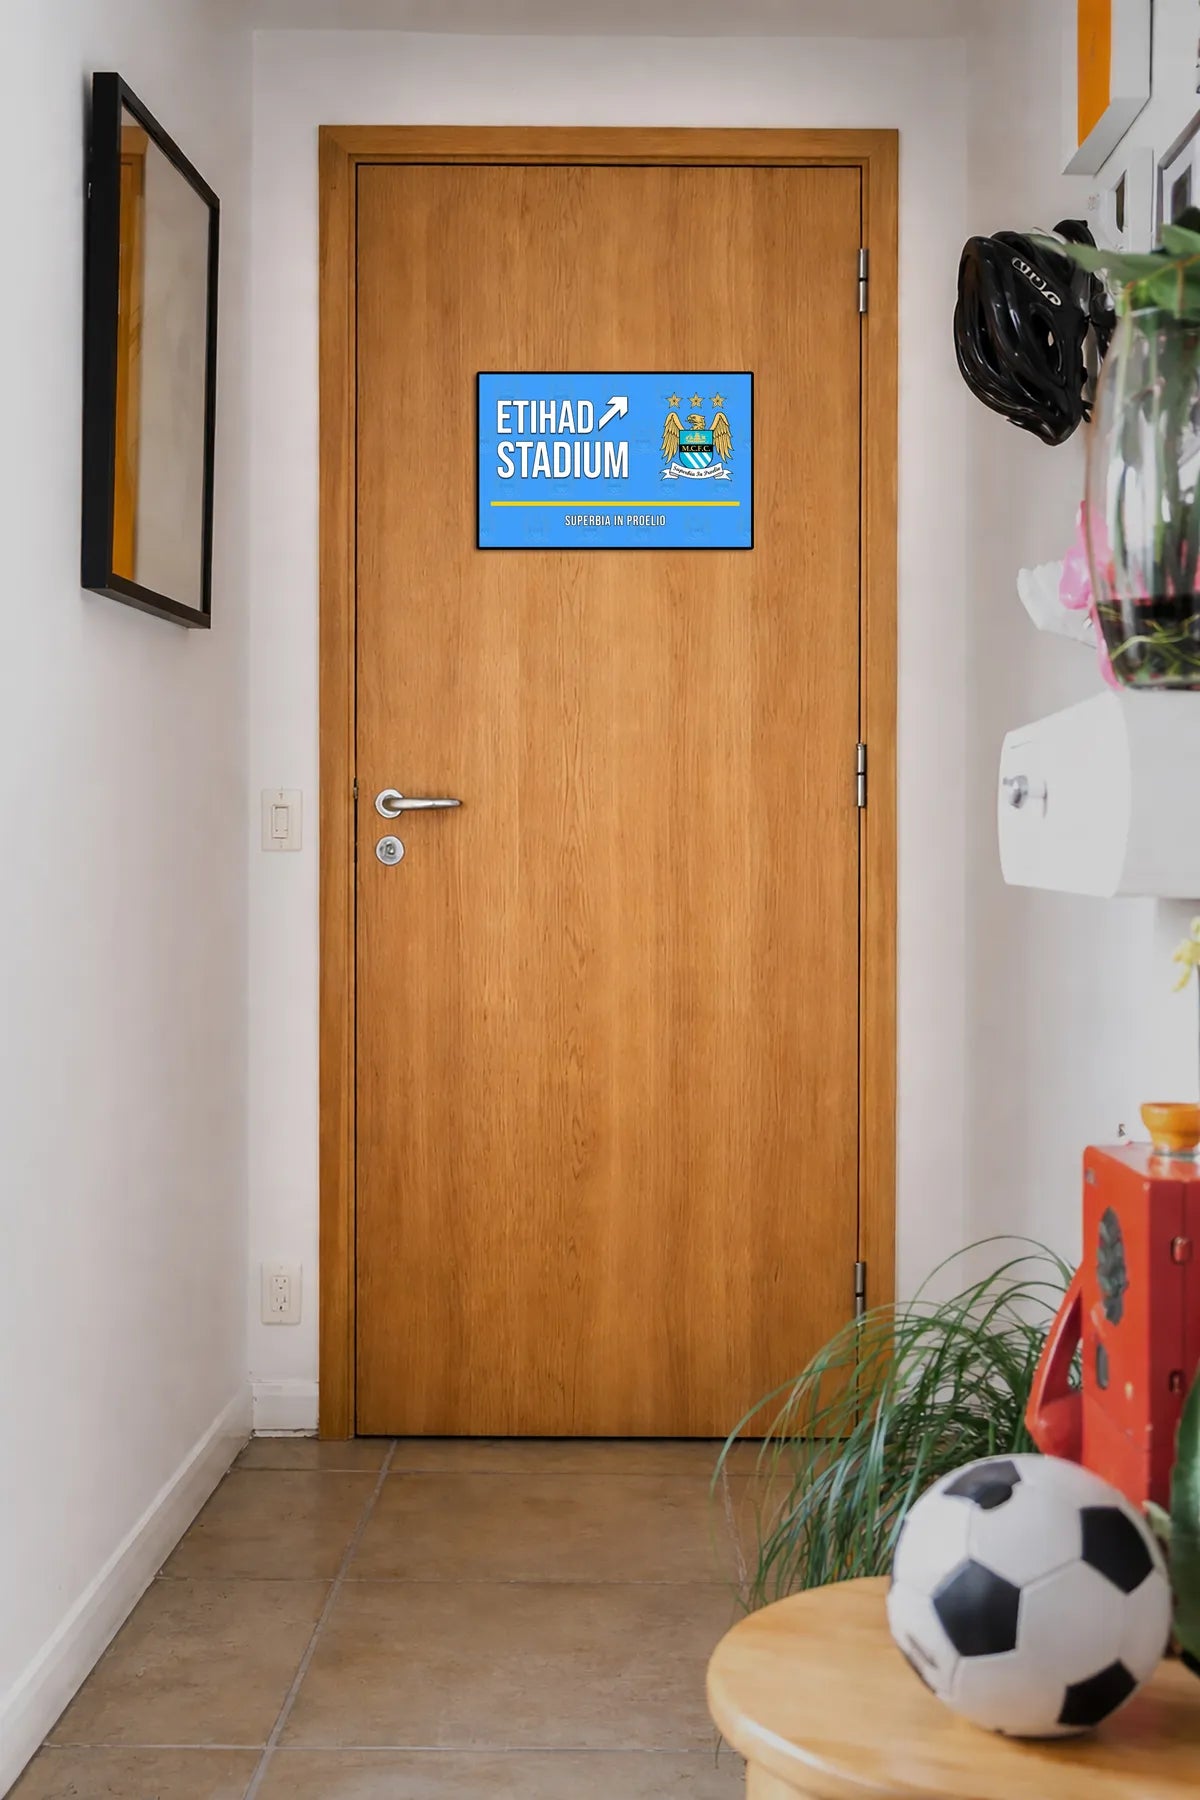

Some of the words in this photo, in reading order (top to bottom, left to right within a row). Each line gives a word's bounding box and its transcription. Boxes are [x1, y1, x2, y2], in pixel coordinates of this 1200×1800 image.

[497, 400, 594, 434] ETIHAD
[497, 441, 629, 479] STADIUM
[565, 515, 611, 526] SUPERBIA
[614, 515, 624, 526] IN
[627, 515, 666, 526] PROELIO
